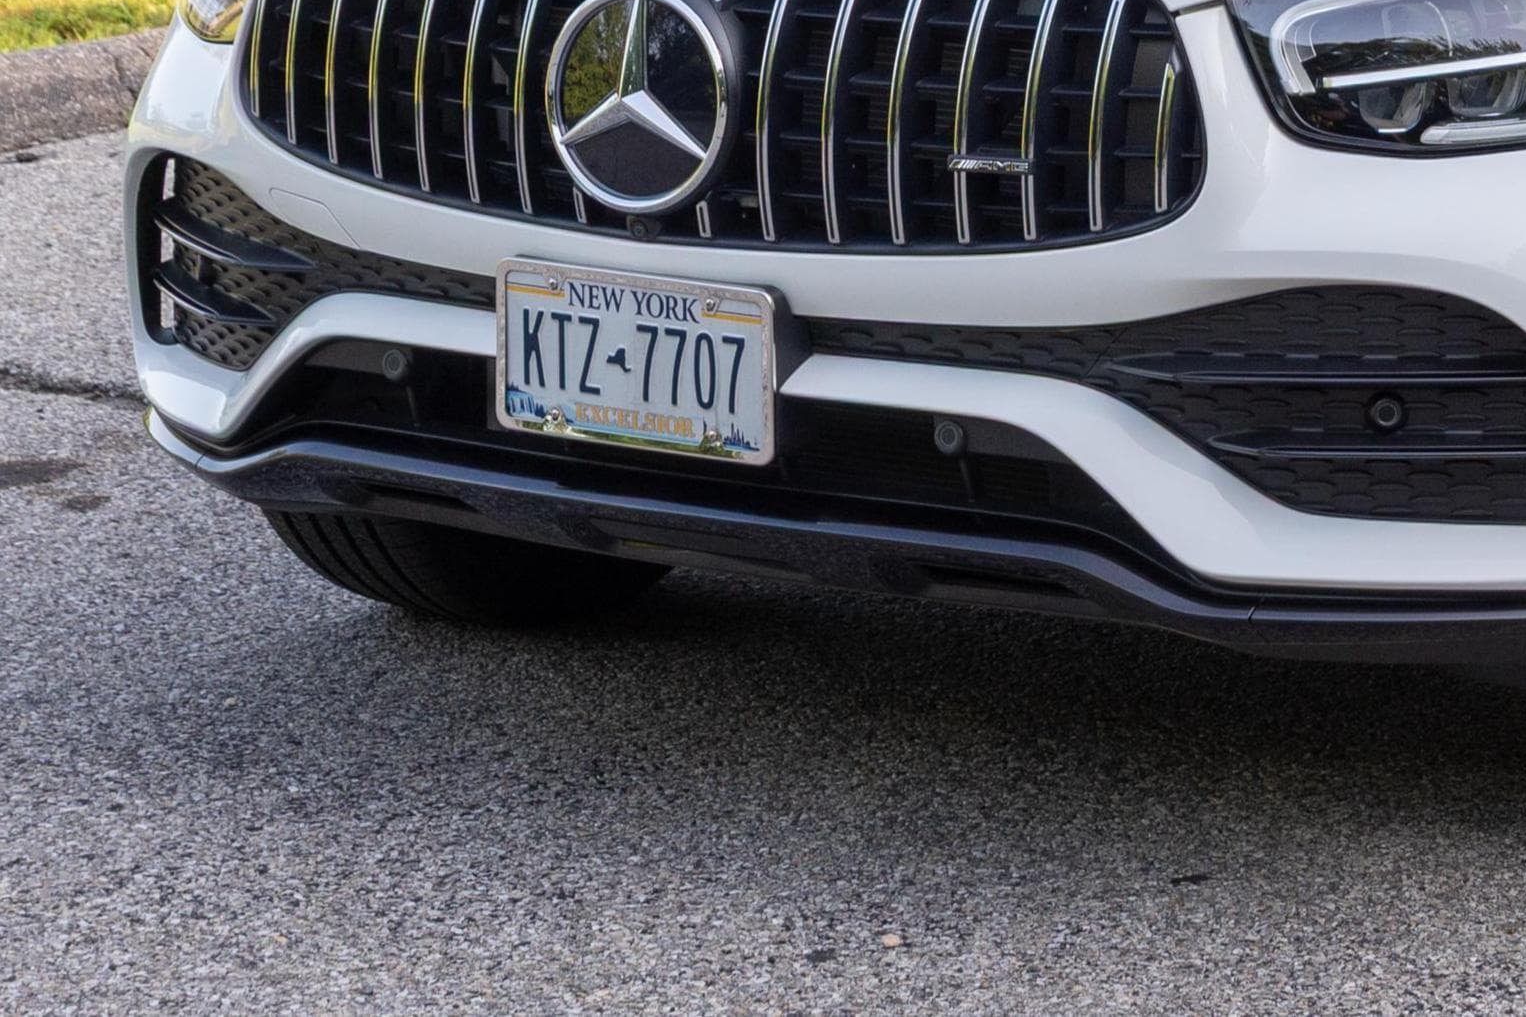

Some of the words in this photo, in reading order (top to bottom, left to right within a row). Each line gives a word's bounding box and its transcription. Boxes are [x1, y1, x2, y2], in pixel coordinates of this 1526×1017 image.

[568, 282, 625, 313] NEW
[630, 290, 700, 323] YORK
[522, 307, 601, 395] KTZ
[636, 323, 746, 415] 7707
[576, 404, 696, 438] EXCELSIOR
